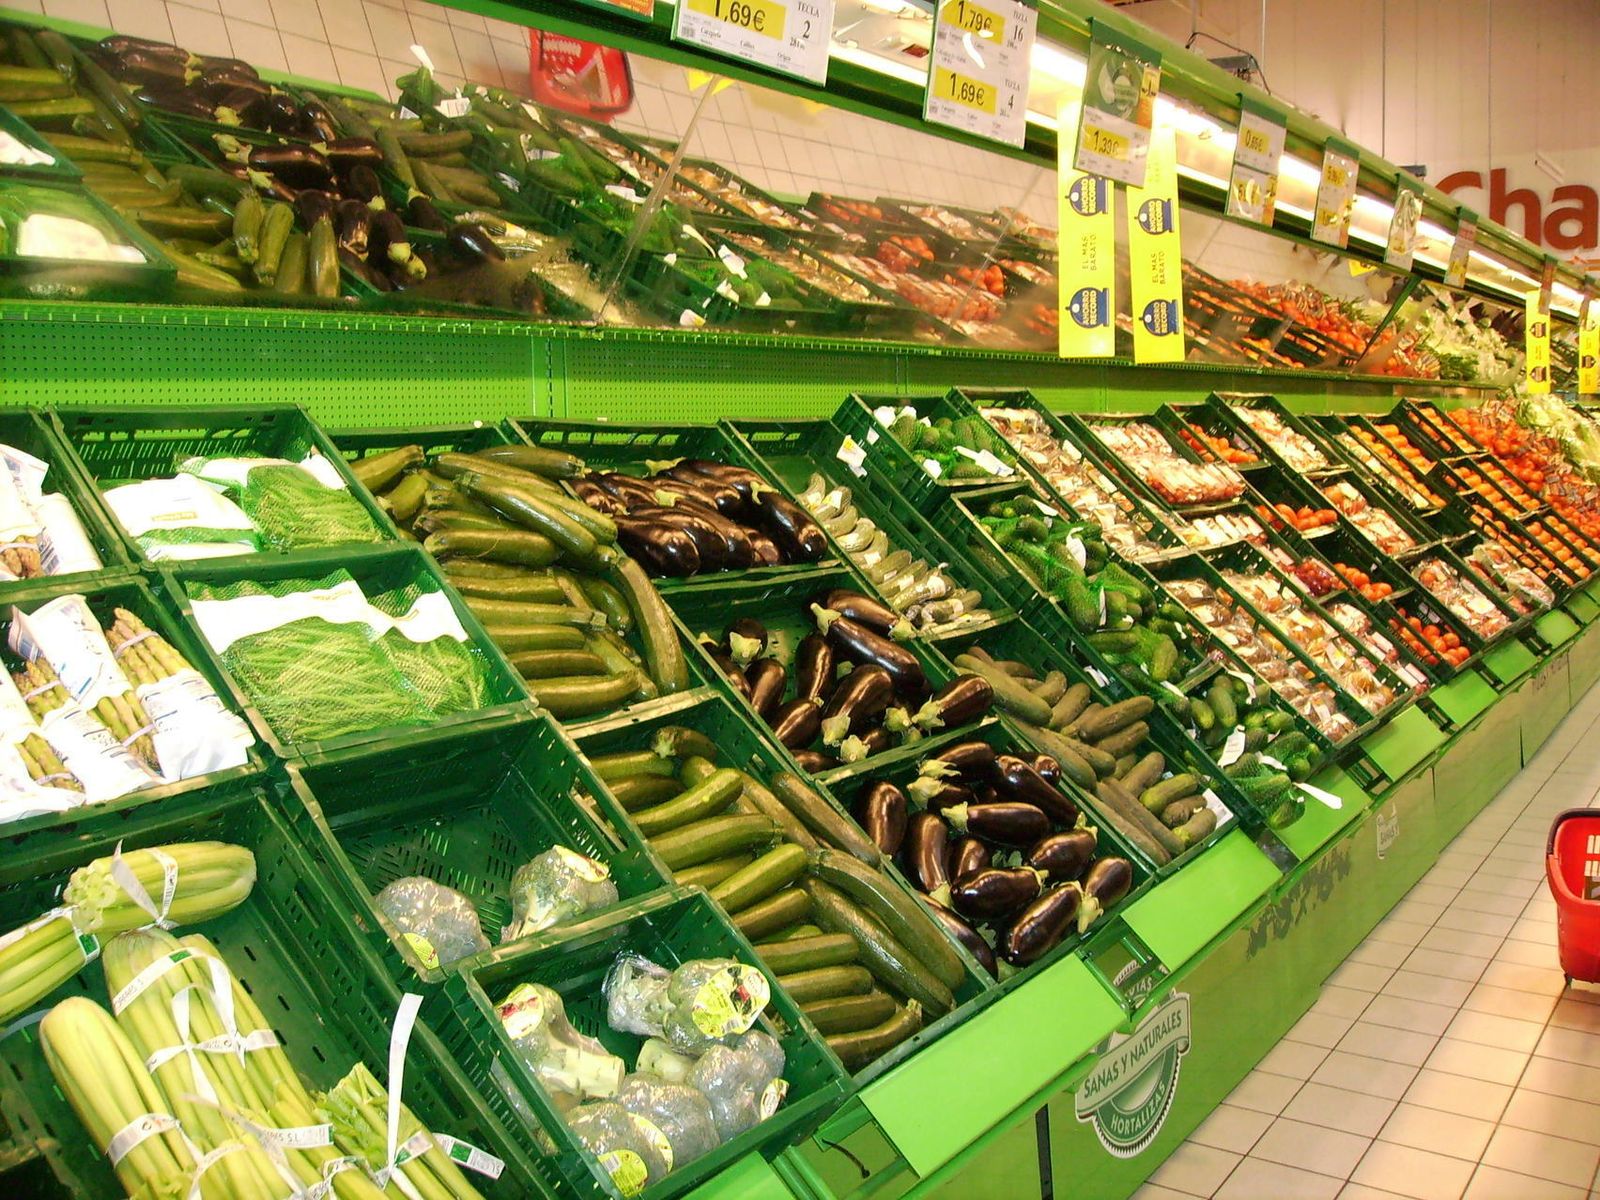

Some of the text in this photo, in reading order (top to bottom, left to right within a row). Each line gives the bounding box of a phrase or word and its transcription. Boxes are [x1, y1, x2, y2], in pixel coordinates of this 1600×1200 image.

[713, 0, 766, 32] 1,69€
[802, 20, 811, 39] 2
[1013, 25, 1024, 42] 16
[950, 72, 985, 106] 1,69€
[1007, 94, 1014, 110] 4
[1080, 177, 1089, 214] AHORRO
[1088, 177, 1096, 214] RECORD
[1155, 200, 1163, 233] RECORD
[1089, 233, 1097, 271] BARATO
[1158, 251, 1166, 285] BARATO
[1081, 290, 1090, 326] AHORRO
[1089, 290, 1097, 326] RECORD
[1160, 301, 1168, 334] RECORD
[1083, 1009, 1183, 1099] SANAS Y NATURALES
[1110, 1080, 1166, 1136] HORTALIZAS
